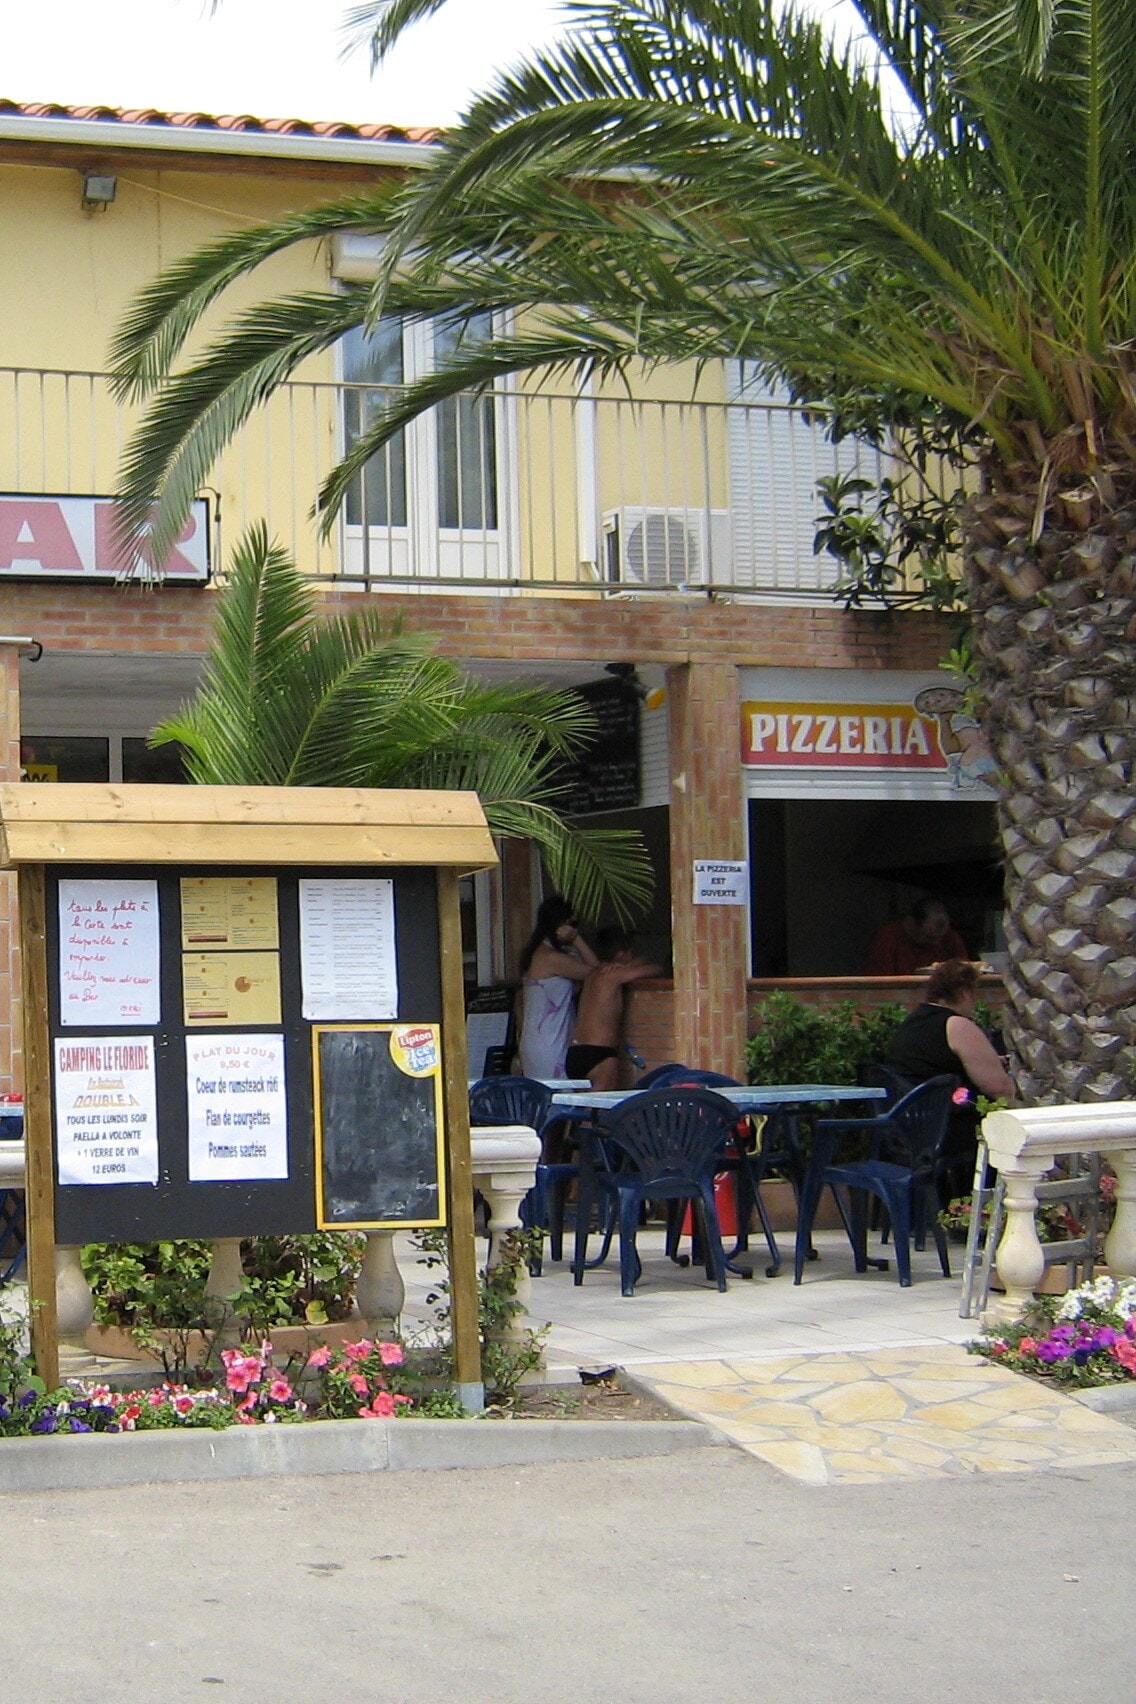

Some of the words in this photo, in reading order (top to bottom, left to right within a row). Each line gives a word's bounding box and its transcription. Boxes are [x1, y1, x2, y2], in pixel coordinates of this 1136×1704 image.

[750, 713, 930, 755] PIZZERIA
[711, 877, 726, 885] EST
[701, 889, 736, 897] OUVERTE
[400, 1031, 432, 1047] Lipton
[59, 1046, 102, 1072] CAMPING
[103, 1046, 113, 1071] LE
[114, 1045, 149, 1071] FLORIDE
[192, 1046, 222, 1062] PLAT
[225, 1046, 241, 1055] DU
[243, 1046, 276, 1061] JOUR
[409, 1046, 431, 1059] Ice
[243, 1060, 251, 1069] €
[218, 1076, 227, 1093] de
[72, 1094, 125, 1108] DOUBLE
[127, 1093, 140, 1107] A
[66, 1115, 85, 1125] TOUS
[87, 1115, 101, 1125] LES
[102, 1114, 128, 1124] LUNDIS
[130, 1113, 147, 1123] SOIR
[206, 1109, 221, 1126] Flan
[223, 1109, 232, 1126] de
[233, 1109, 270, 1130] courgettes
[73, 1131, 100, 1142] PAELLA
[101, 1131, 107, 1140] A
[109, 1129, 142, 1140] VOLONTE
[90, 1148, 114, 1158] VERRE
[115, 1147, 125, 1157] DE
[127, 1147, 139, 1156] VIN
[208, 1142, 238, 1158] Pommes
[240, 1140, 267, 1158] sautées
[92, 1165, 101, 1174] 12
[102, 1163, 126, 1174] EUROS
